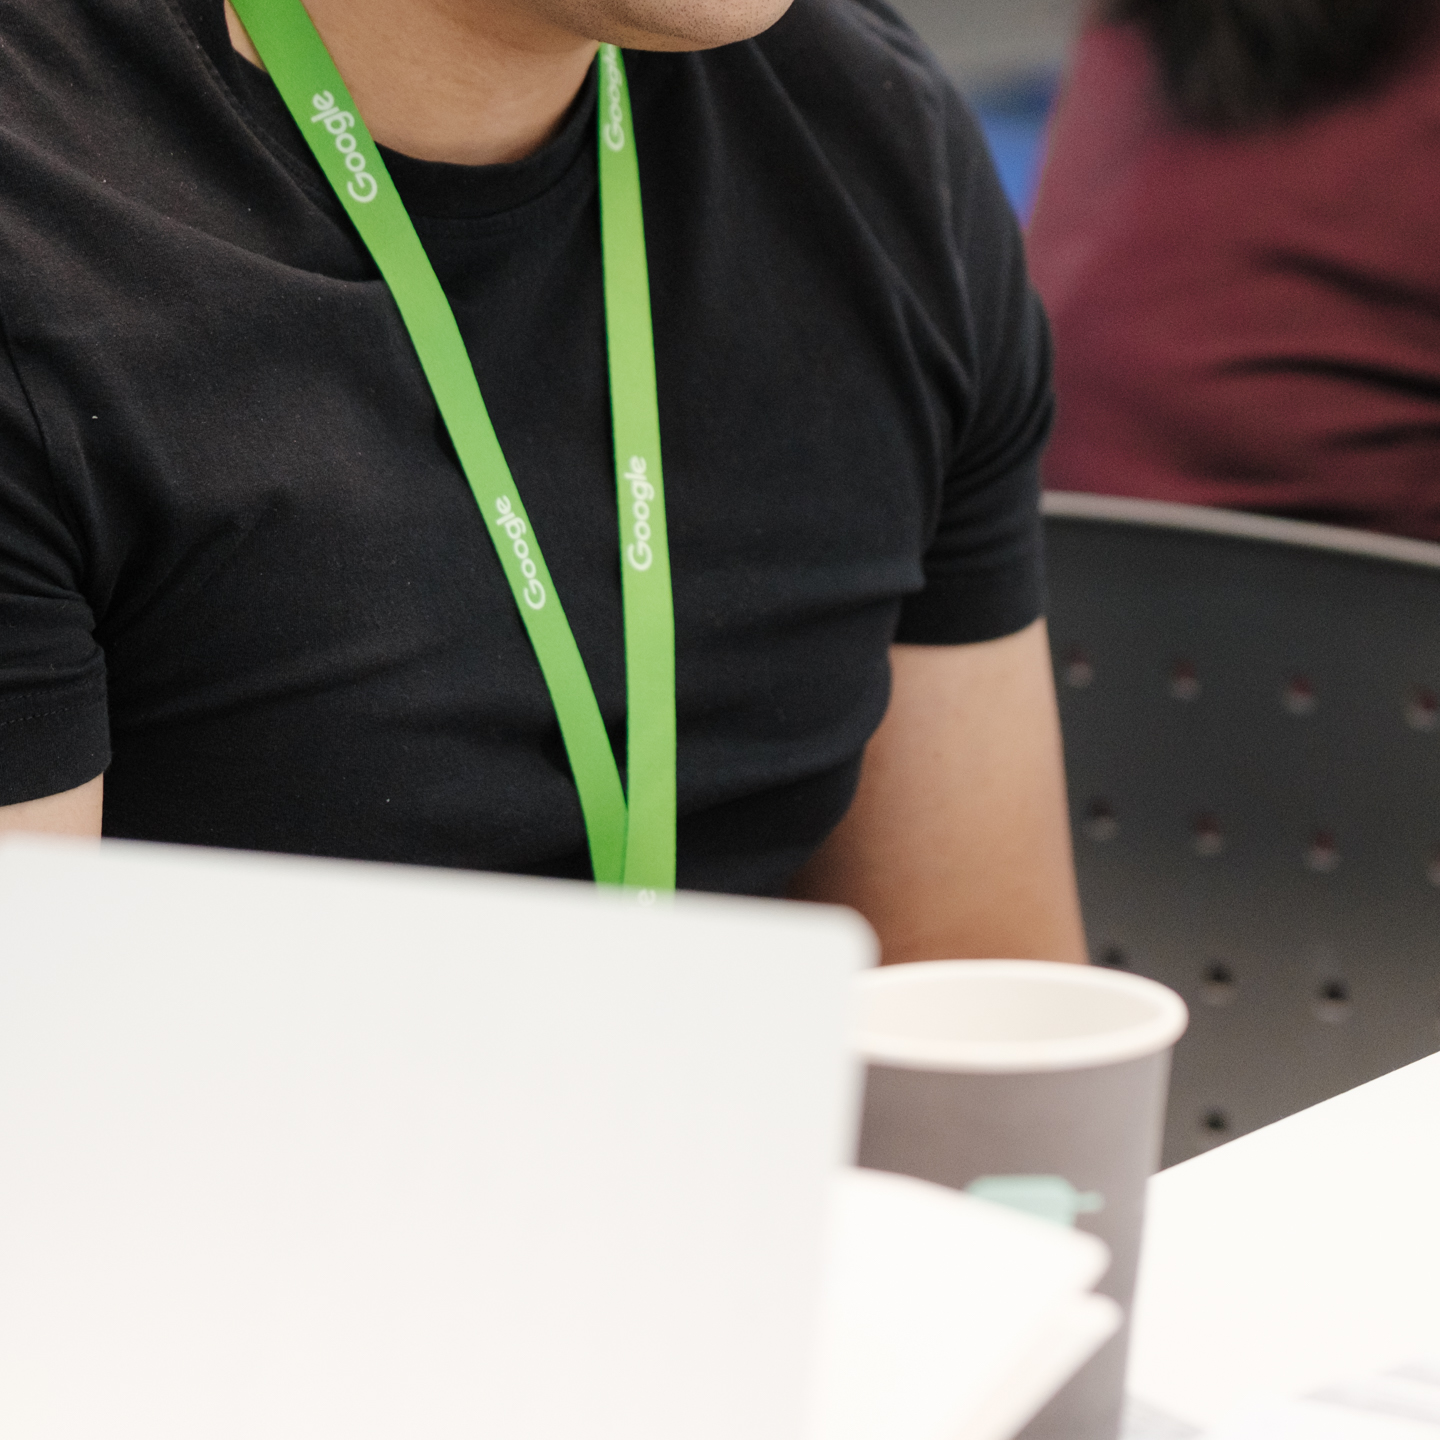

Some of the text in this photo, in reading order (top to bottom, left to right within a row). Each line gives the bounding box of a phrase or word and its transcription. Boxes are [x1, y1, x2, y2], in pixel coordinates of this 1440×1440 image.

[311, 90, 378, 203] Google
[496, 495, 546, 610] Google
[624, 455, 655, 571] Google
